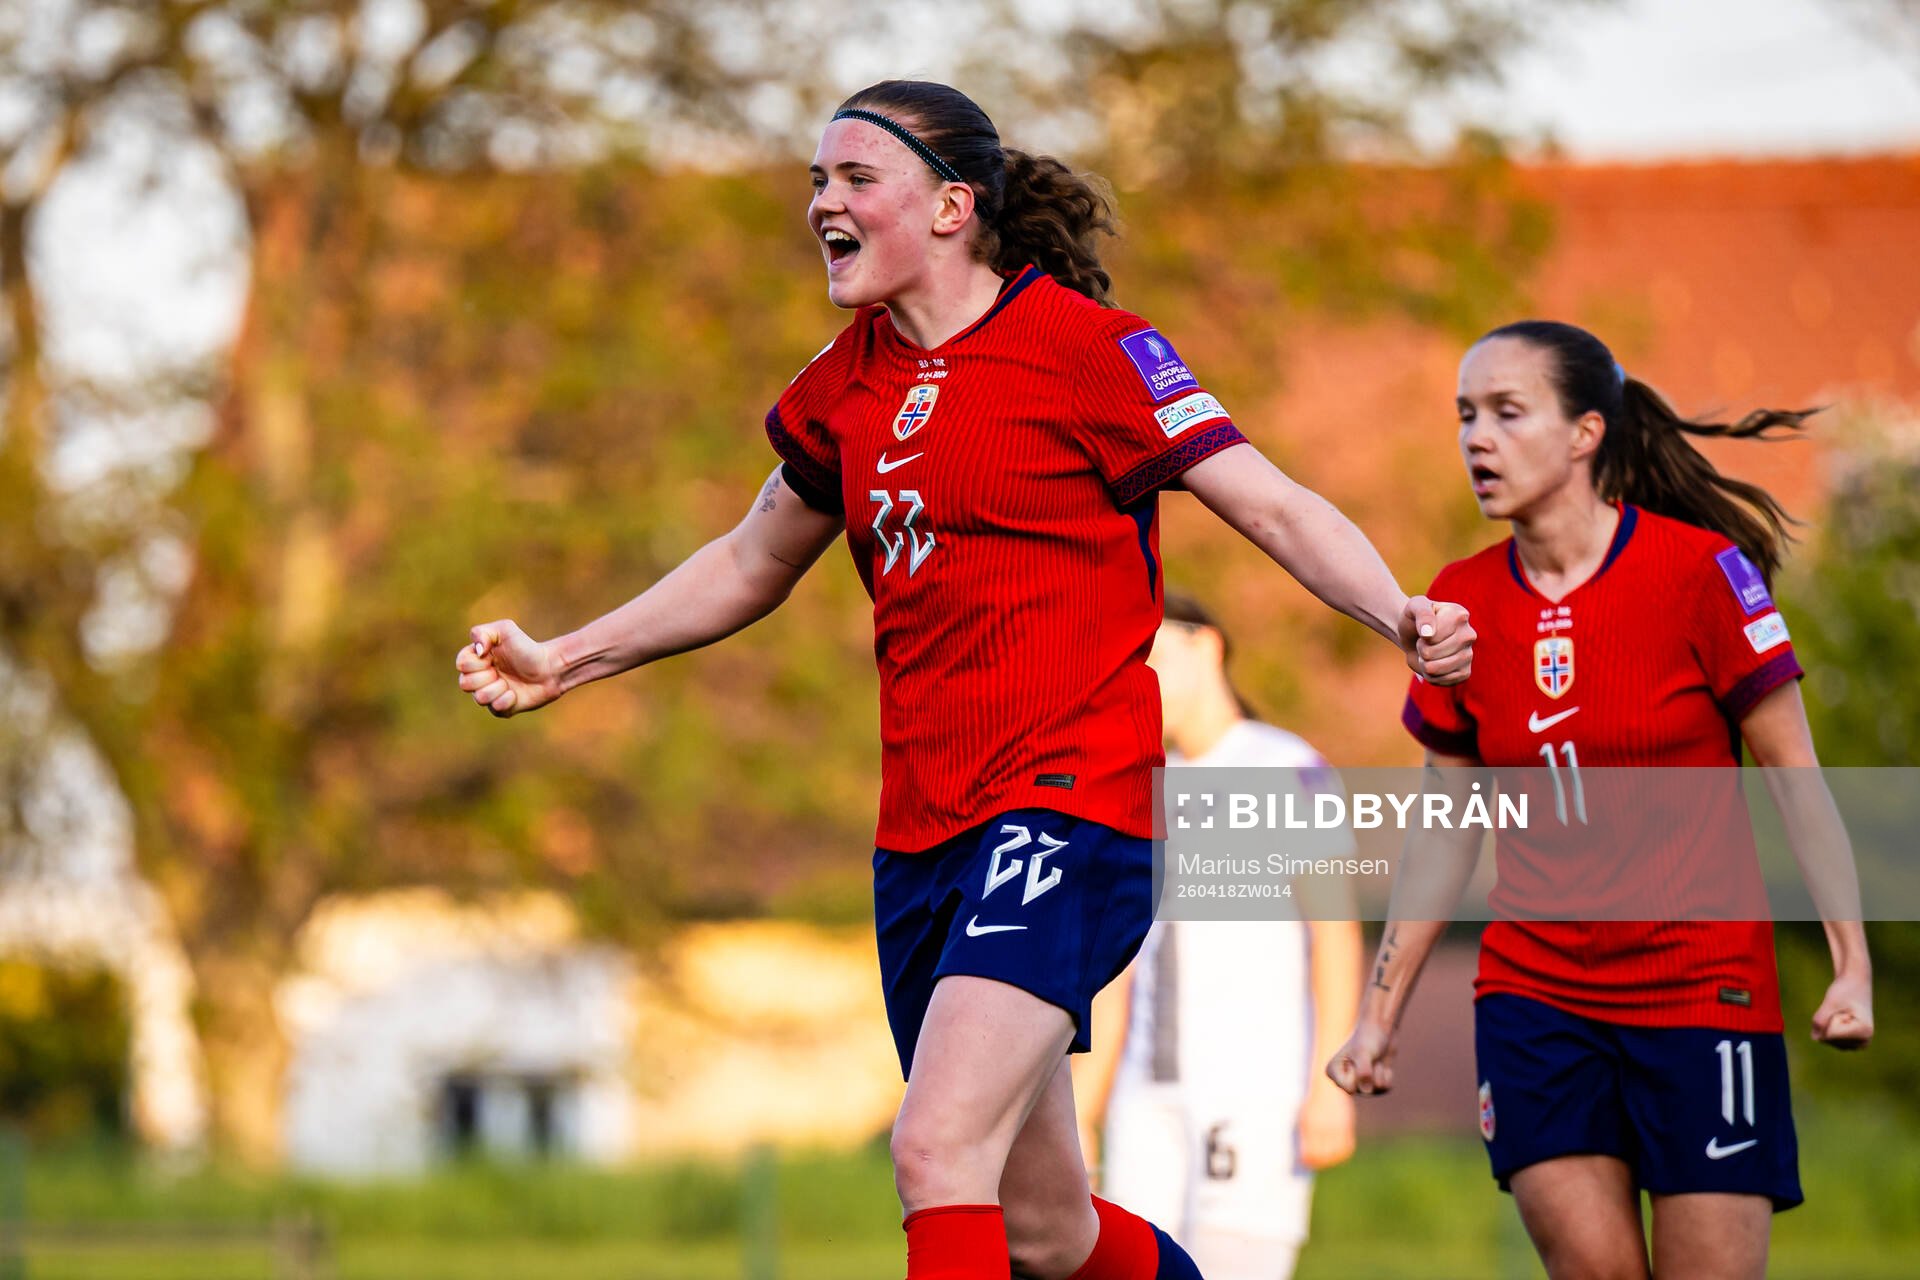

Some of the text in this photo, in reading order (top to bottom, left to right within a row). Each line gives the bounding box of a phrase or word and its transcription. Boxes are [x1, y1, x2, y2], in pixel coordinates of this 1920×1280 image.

[1157, 406, 1176, 419] UEFA
[869, 489, 936, 579] 22
[1539, 740, 1588, 828] 11
[982, 824, 1070, 906] 22
[1715, 1039, 1755, 1127] 11
[1205, 1118, 1237, 1181] 6
